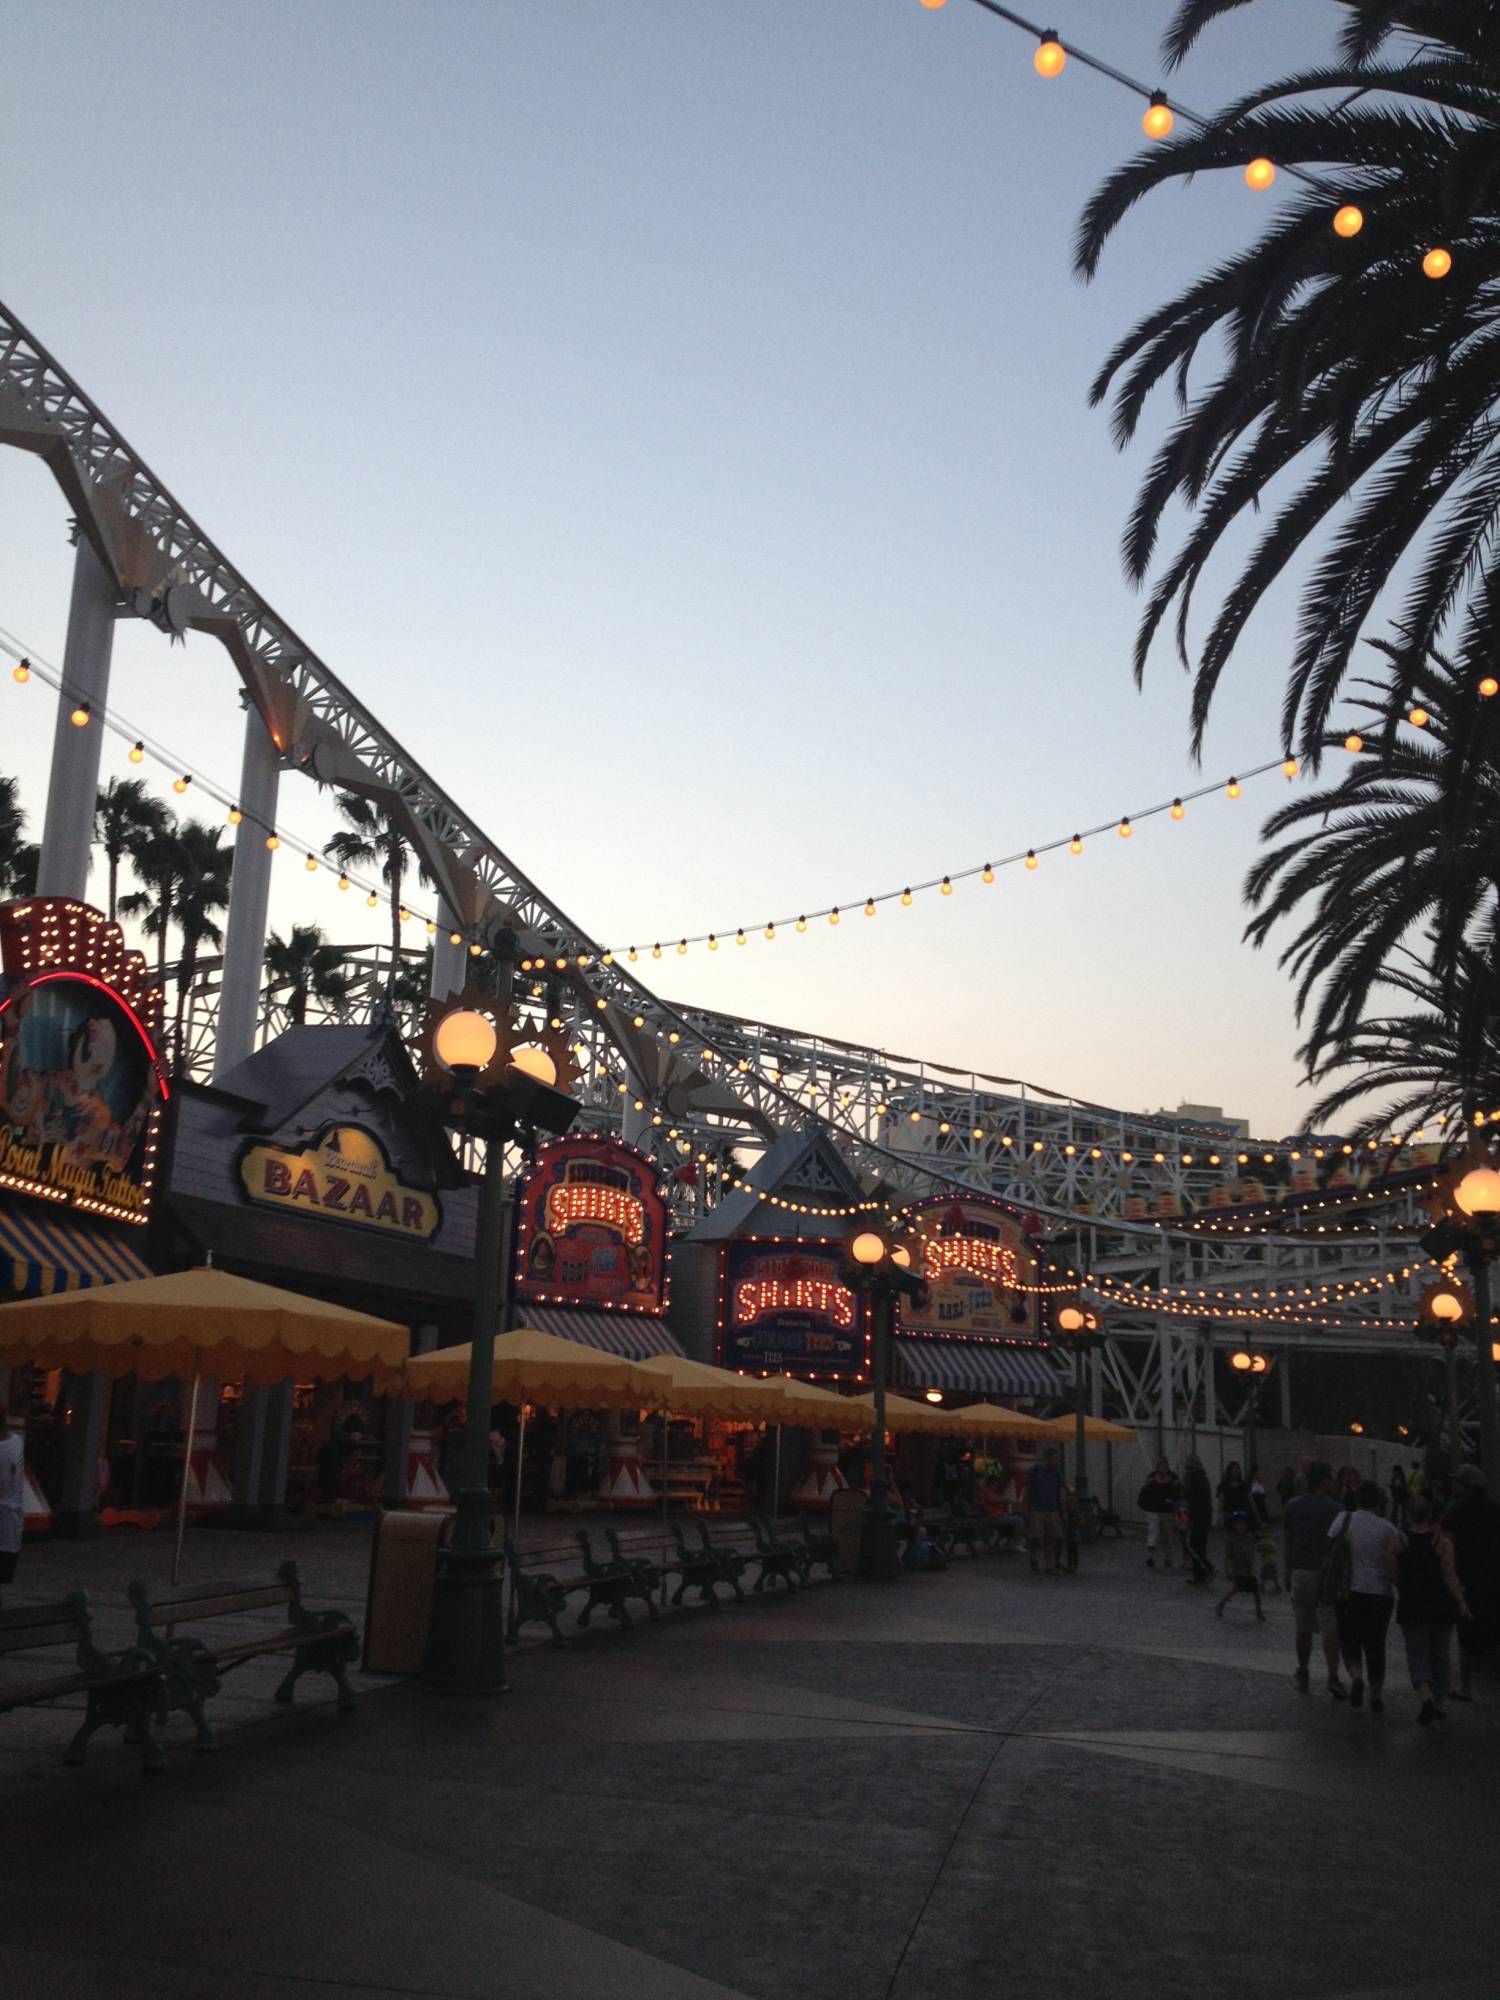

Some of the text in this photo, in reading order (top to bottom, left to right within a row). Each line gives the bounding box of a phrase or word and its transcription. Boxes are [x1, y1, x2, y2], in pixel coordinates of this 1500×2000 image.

[42, 1143, 97, 1198] Mugu
[264, 1159, 423, 1230] BAZAAR
[550, 1184, 643, 1245] SHIRTS
[924, 1239, 1017, 1288] SHIRTS
[737, 1279, 854, 1328] SHIRTS
